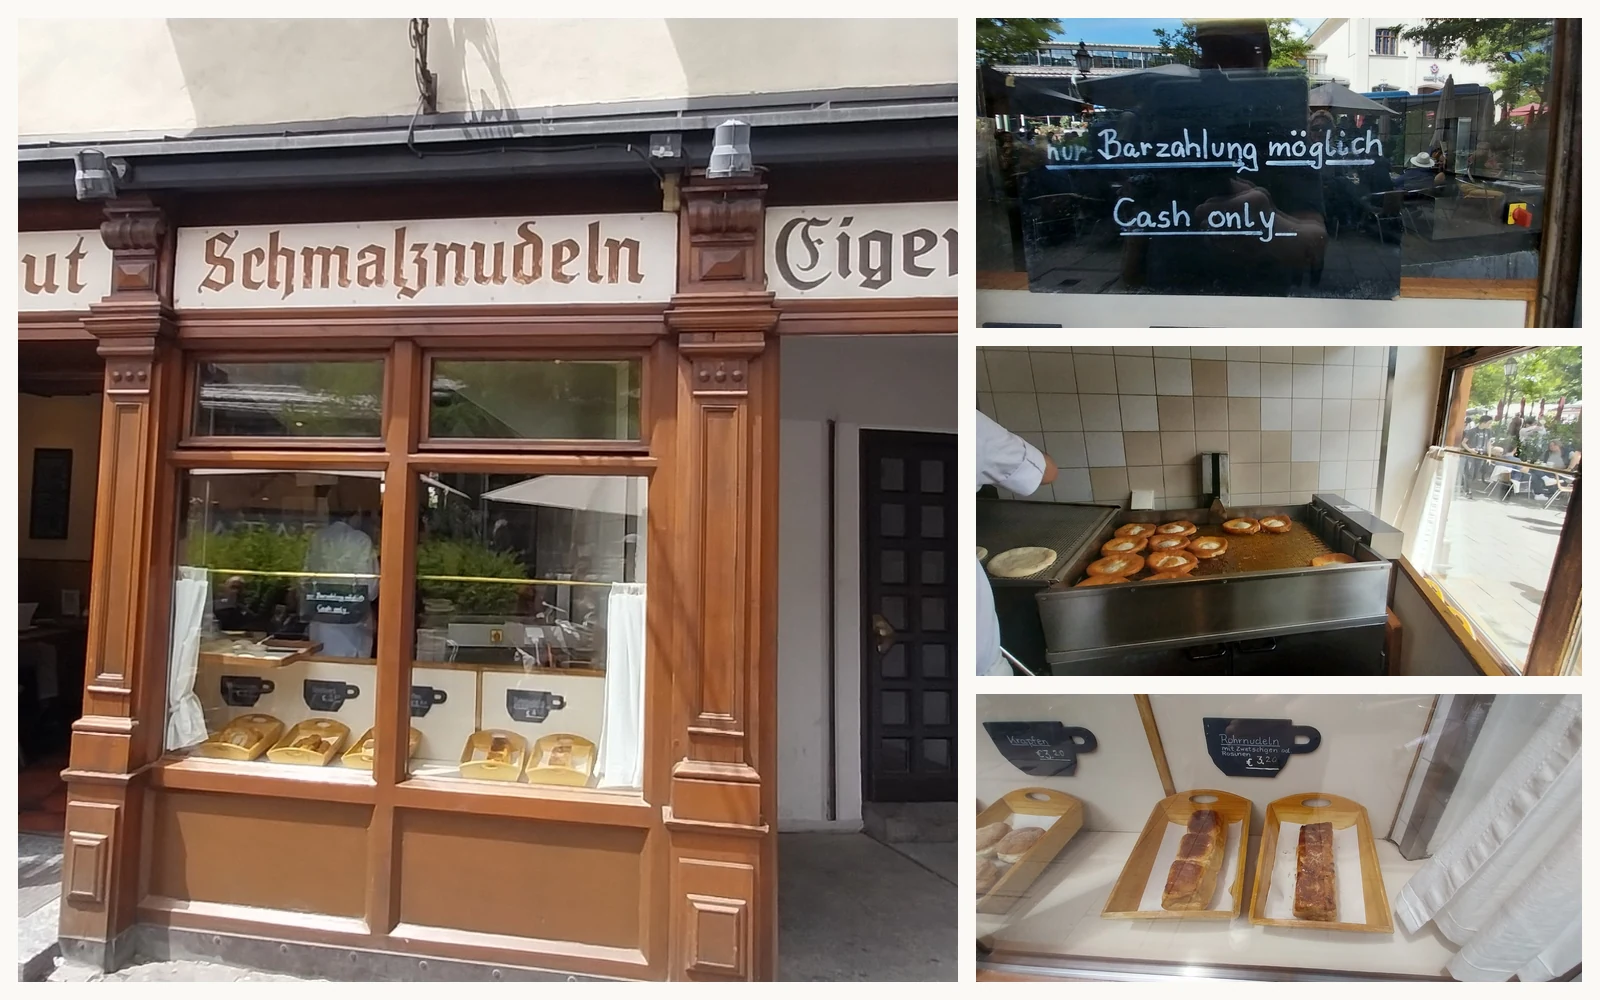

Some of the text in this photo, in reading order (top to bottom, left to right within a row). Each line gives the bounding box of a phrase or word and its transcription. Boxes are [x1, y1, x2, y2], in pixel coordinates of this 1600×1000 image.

[1046, 128, 1384, 173] nur Barzahlung möglich
[1112, 197, 1276, 242] Cash only
[21, 236, 88, 294] ut
[197, 220, 646, 300] Schmalznudeln
[1006, 735, 1050, 748] Krapfen
[1218, 733, 1280, 746] Rohrnudeln
